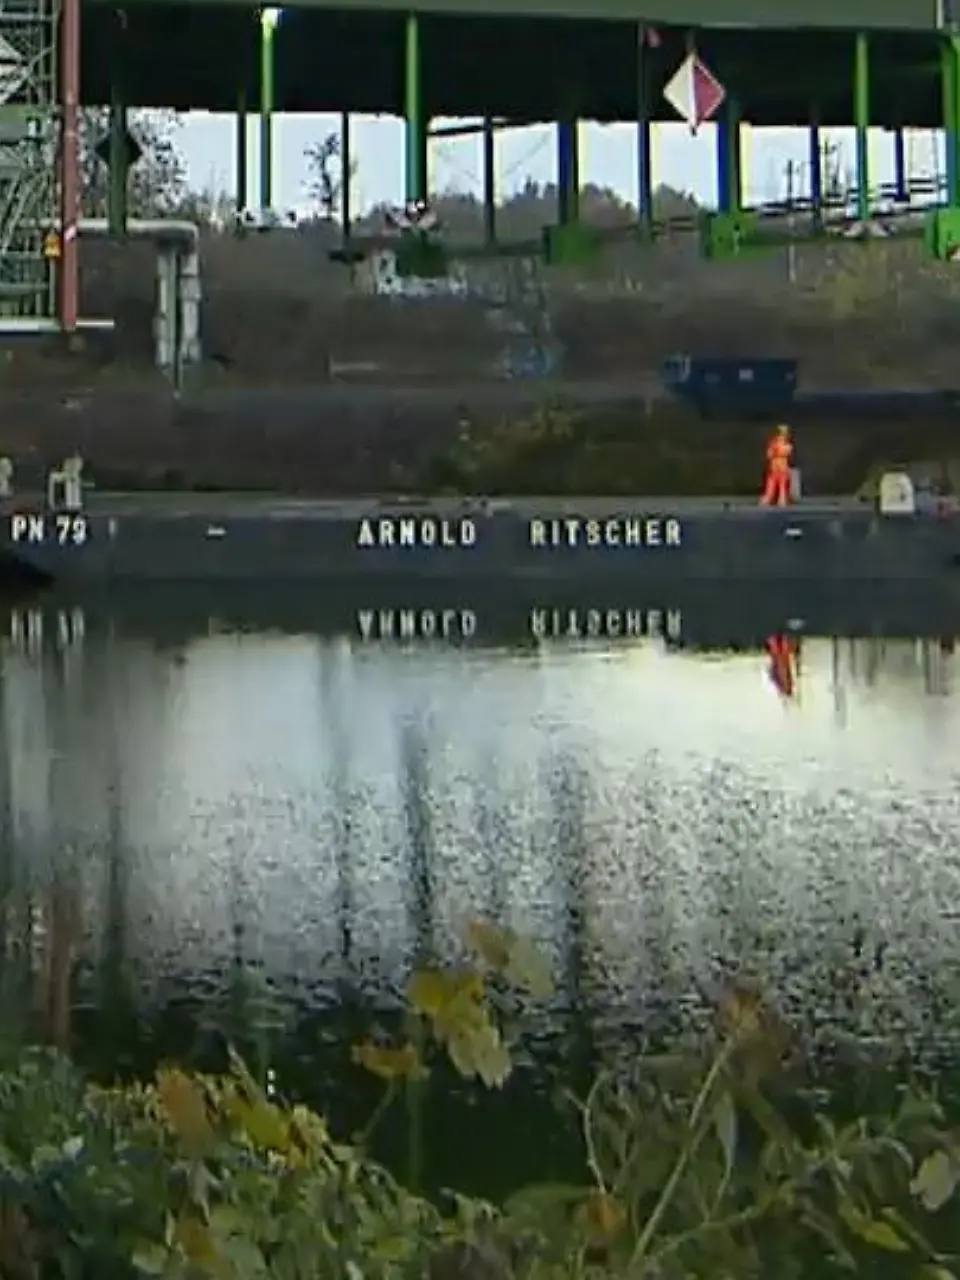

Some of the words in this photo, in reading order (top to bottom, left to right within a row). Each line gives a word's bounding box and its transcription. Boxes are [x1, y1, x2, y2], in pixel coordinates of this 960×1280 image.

[11, 515, 43, 543] PN
[56, 516, 86, 544] 79
[357, 520, 477, 545] ARNOLD
[530, 519, 682, 545] RITSCHER
